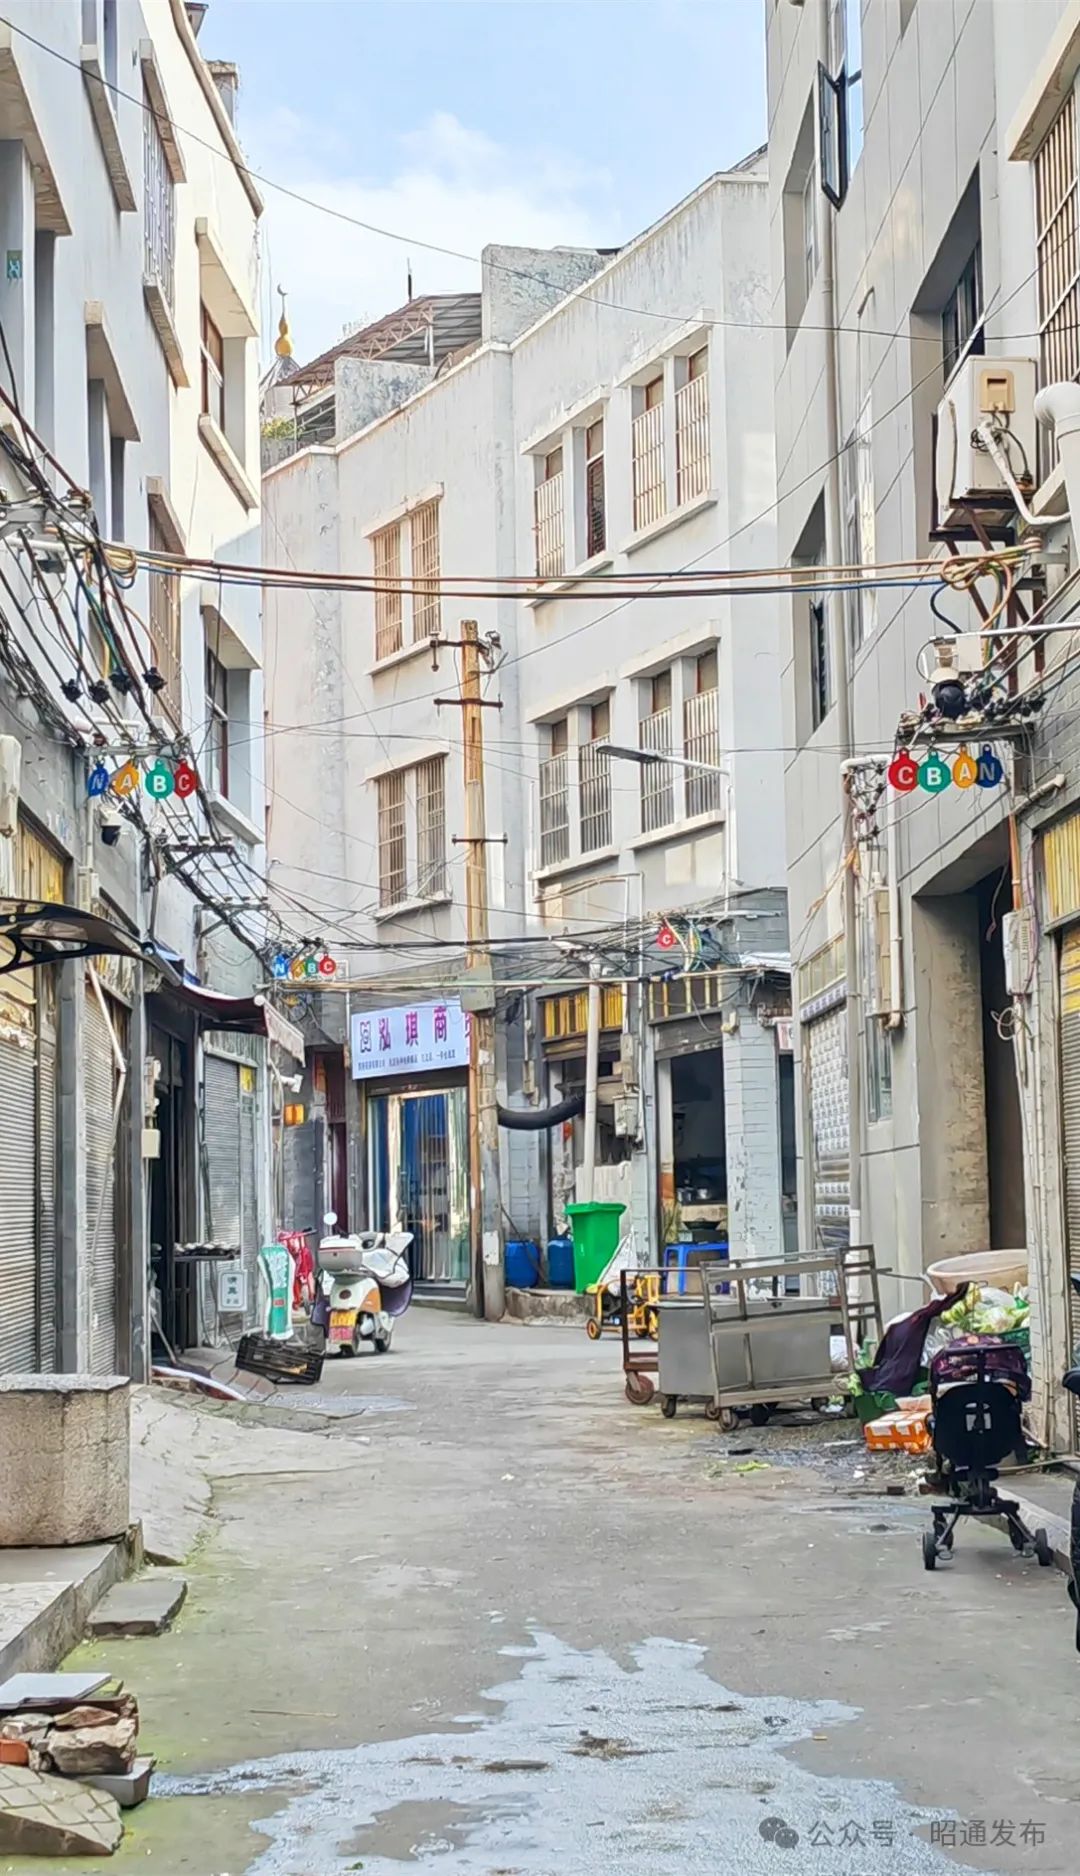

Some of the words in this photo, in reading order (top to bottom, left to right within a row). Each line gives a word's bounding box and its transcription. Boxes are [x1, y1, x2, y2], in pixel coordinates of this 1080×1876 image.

[898, 766, 913, 785] C
[926, 767, 942, 786] B
[960, 763, 971, 781] A
[980, 763, 995, 781] N
[92, 774, 104, 790] N
[121, 774, 132, 788] A
[153, 775, 167, 793] B
[178, 774, 190, 791] C
[662, 934, 671, 945] C
[275, 963, 285, 973] N
[307, 963, 316, 973] B
[323, 961, 333, 972] C
